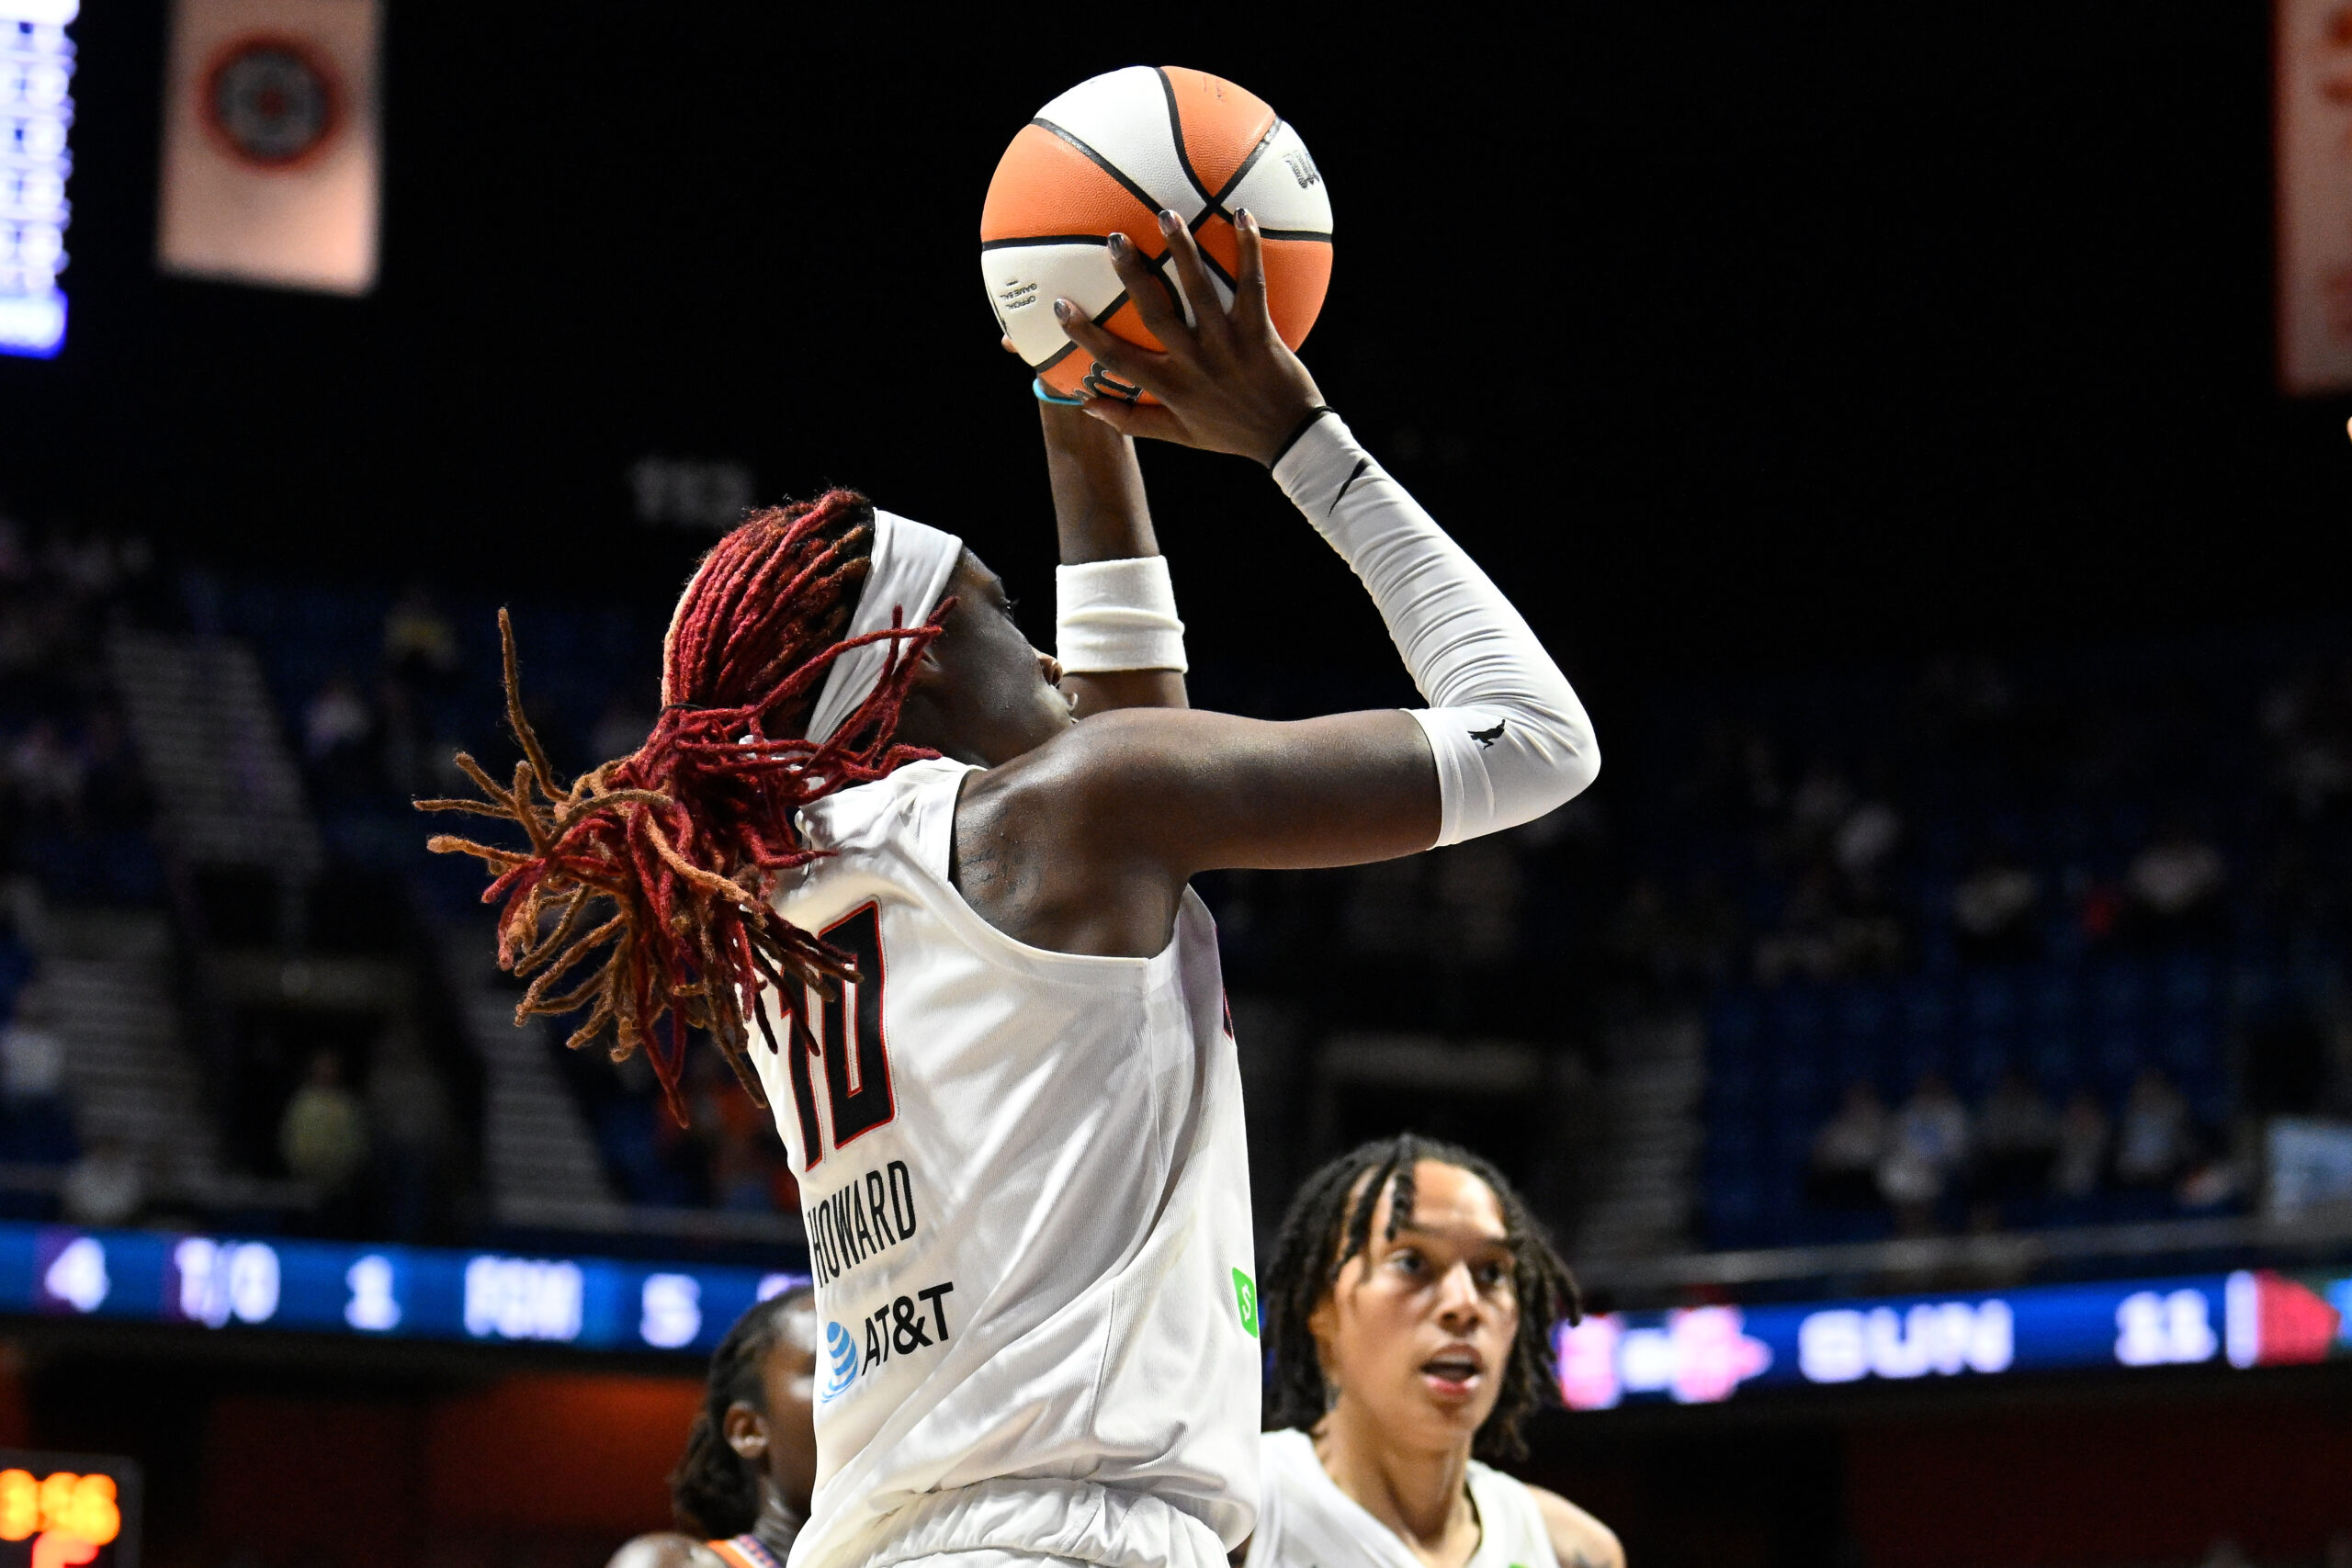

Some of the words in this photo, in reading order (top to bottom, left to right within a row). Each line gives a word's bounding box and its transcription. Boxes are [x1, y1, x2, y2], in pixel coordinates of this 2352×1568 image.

[808, 1160, 916, 1288] HOWARD
[44, 1237, 110, 1313] 4
[345, 1255, 401, 1331] 1
[861, 1281, 954, 1377] AT&T
[1799, 1298, 2015, 1383] SUN
[2115, 1289, 2218, 1366] 11
